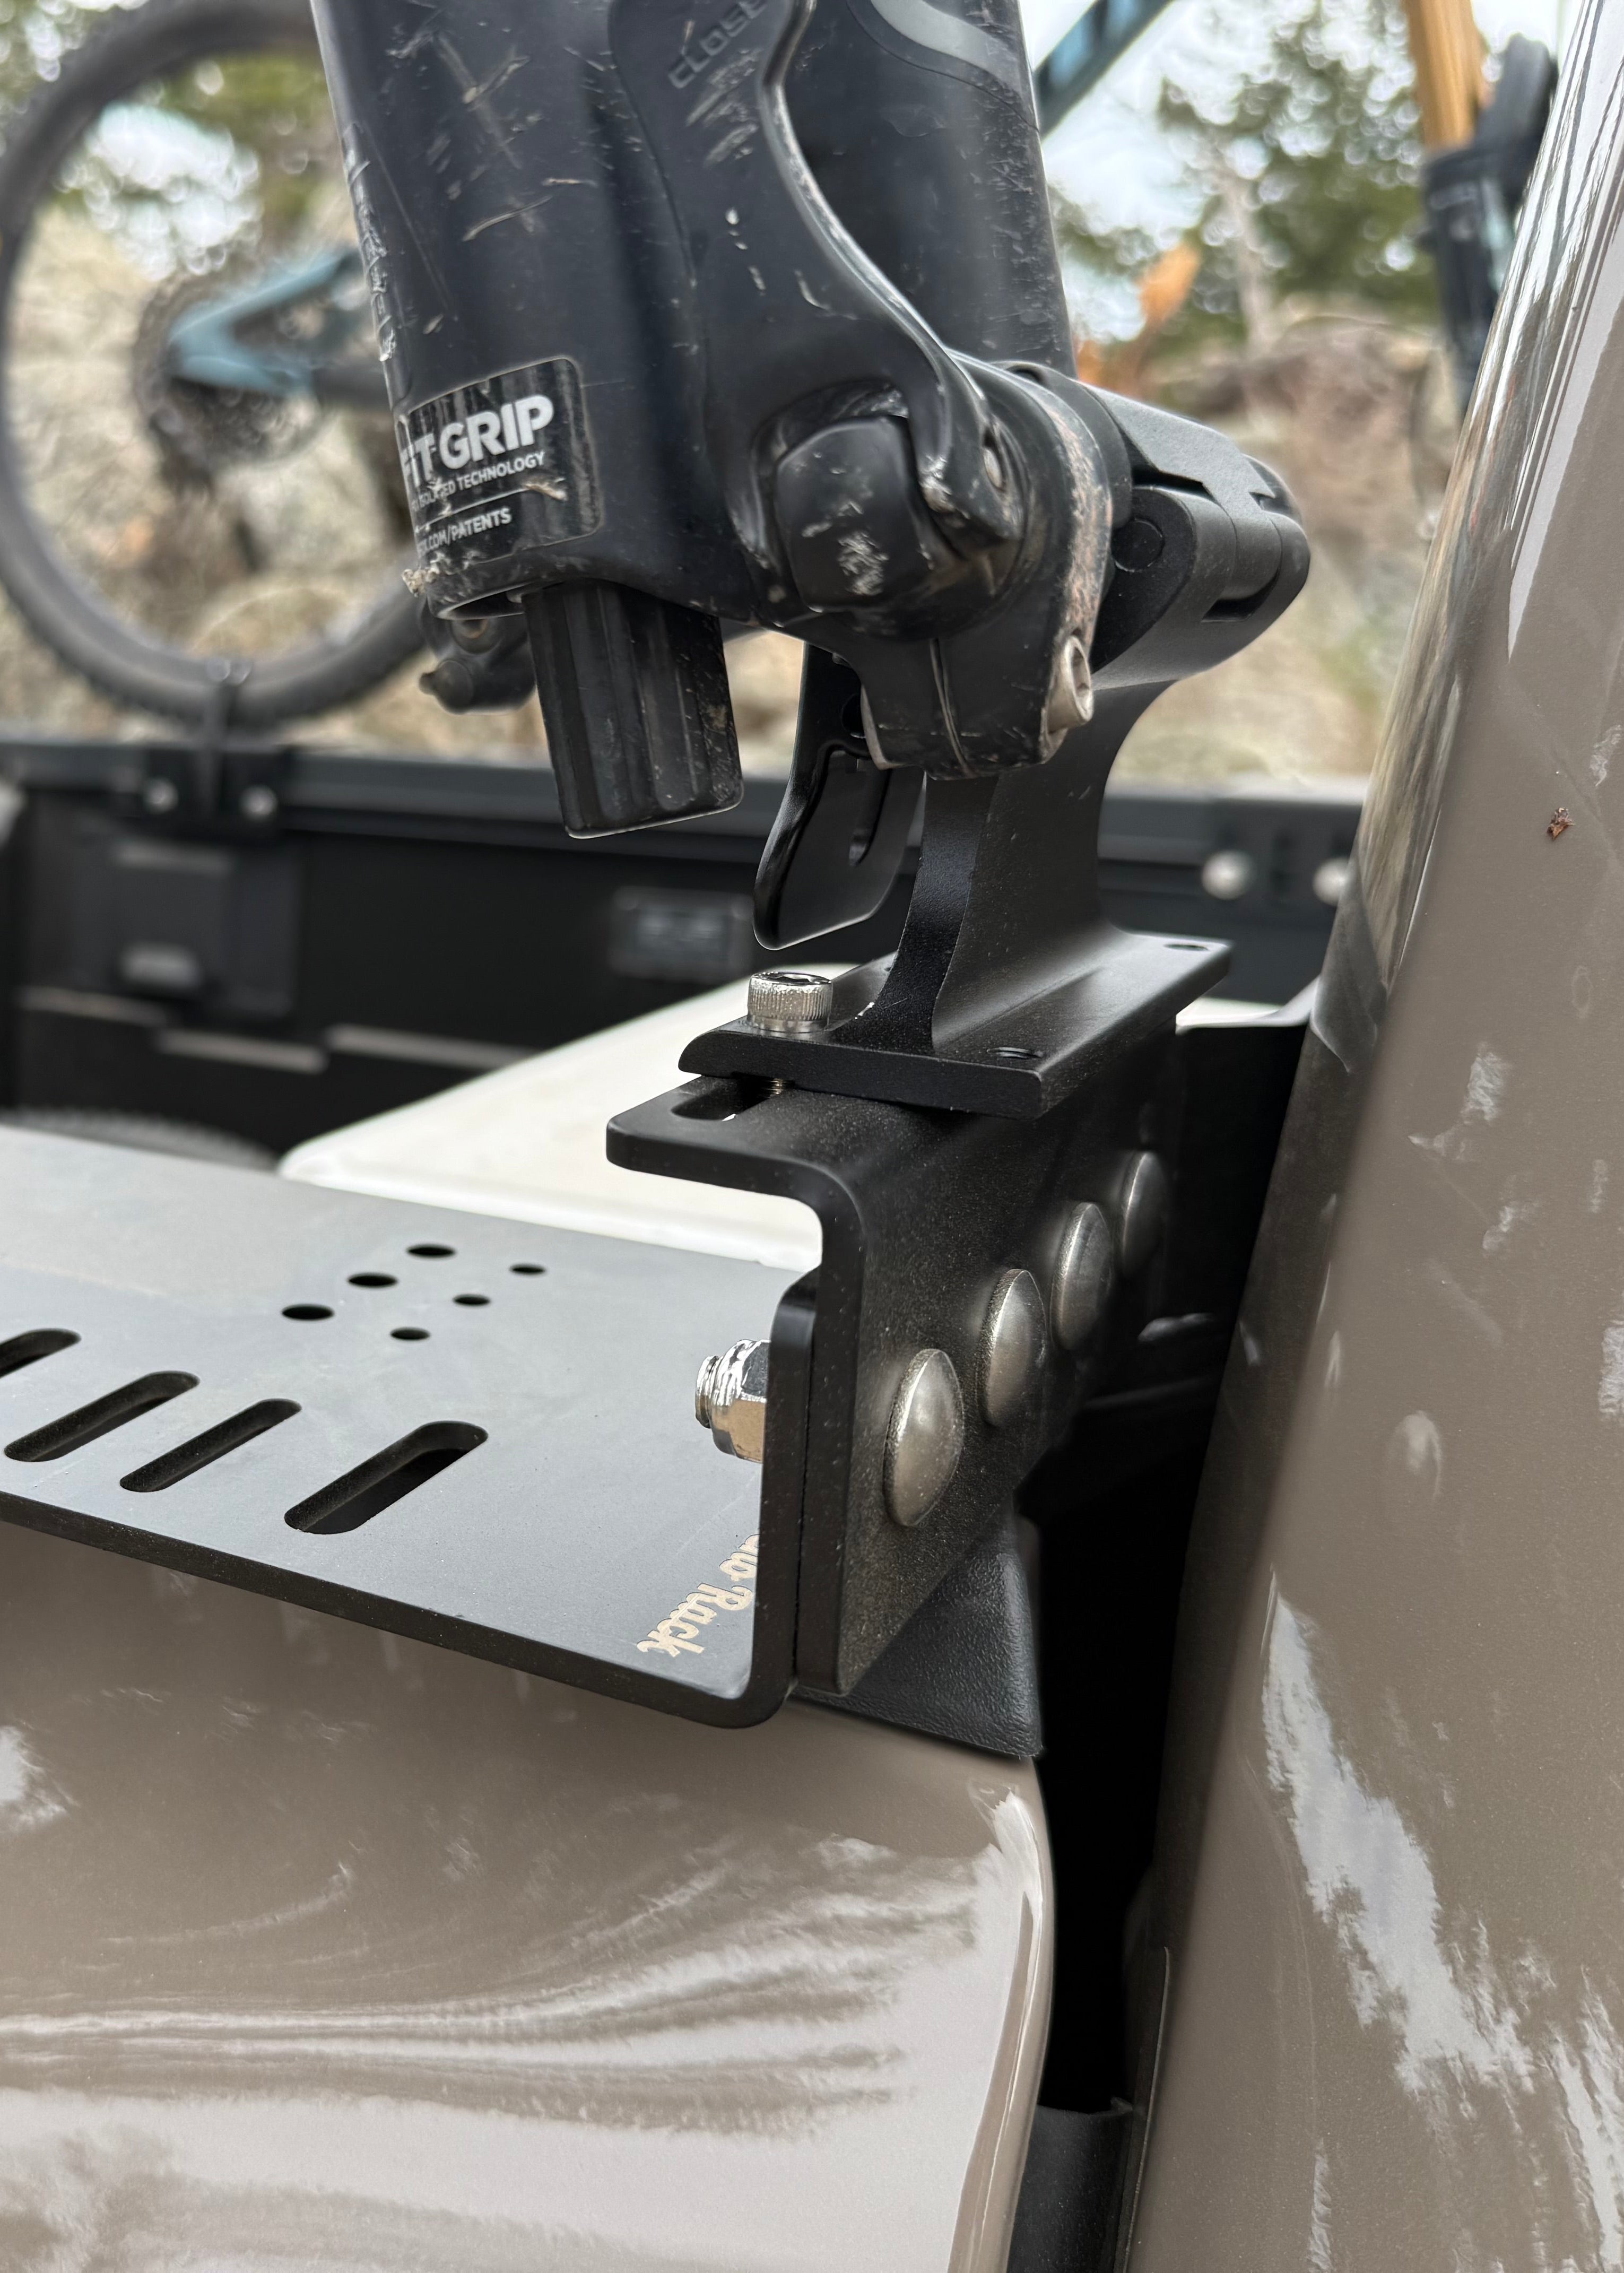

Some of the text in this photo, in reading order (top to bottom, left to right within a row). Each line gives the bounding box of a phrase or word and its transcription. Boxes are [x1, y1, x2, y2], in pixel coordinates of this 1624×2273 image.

[439, 394, 554, 470] GRIP
[457, 450, 546, 491] TECHNOLOGY
[636, 1583, 753, 1658] Rack
